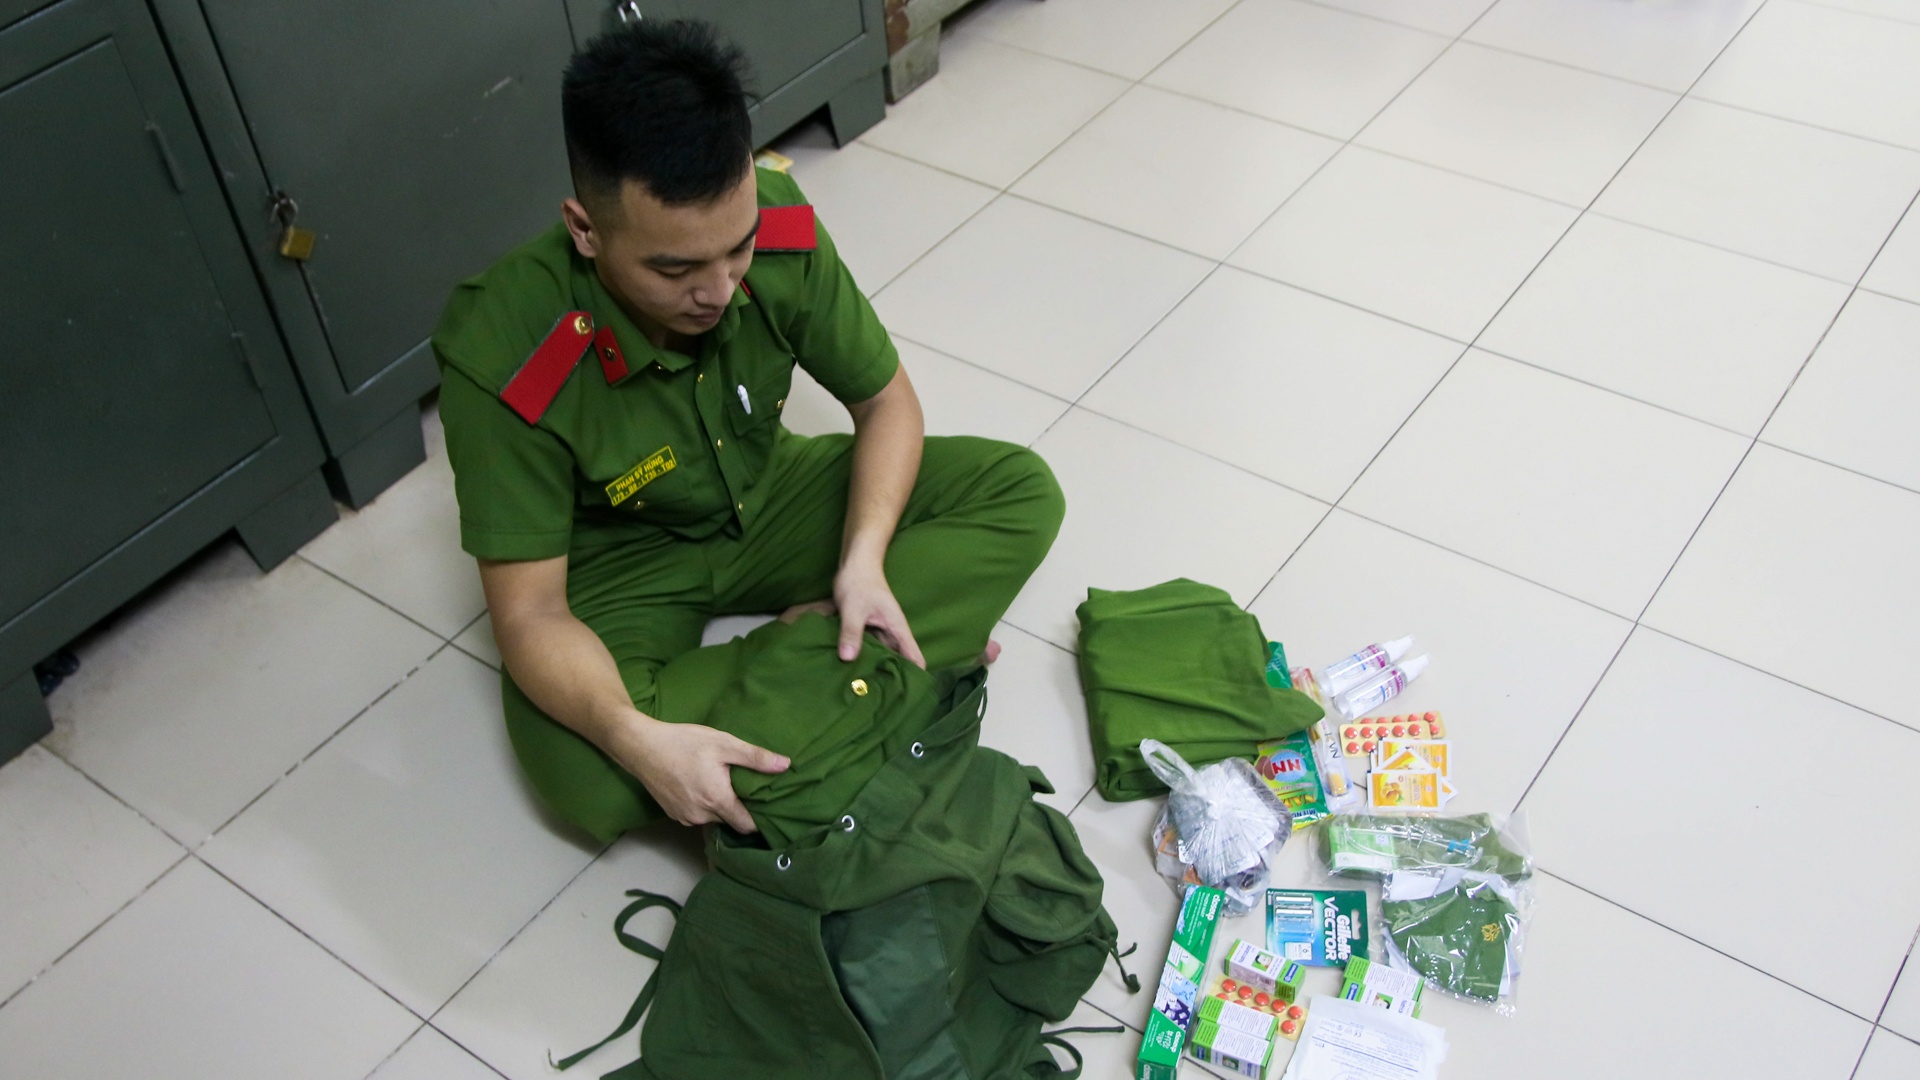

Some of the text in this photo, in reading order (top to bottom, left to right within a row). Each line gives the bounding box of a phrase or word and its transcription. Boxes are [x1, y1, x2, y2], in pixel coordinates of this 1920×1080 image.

[616, 475, 635, 491] PHAN
[1323, 896, 1339, 961] VECTOR
[1336, 914, 1352, 960] Gillette
